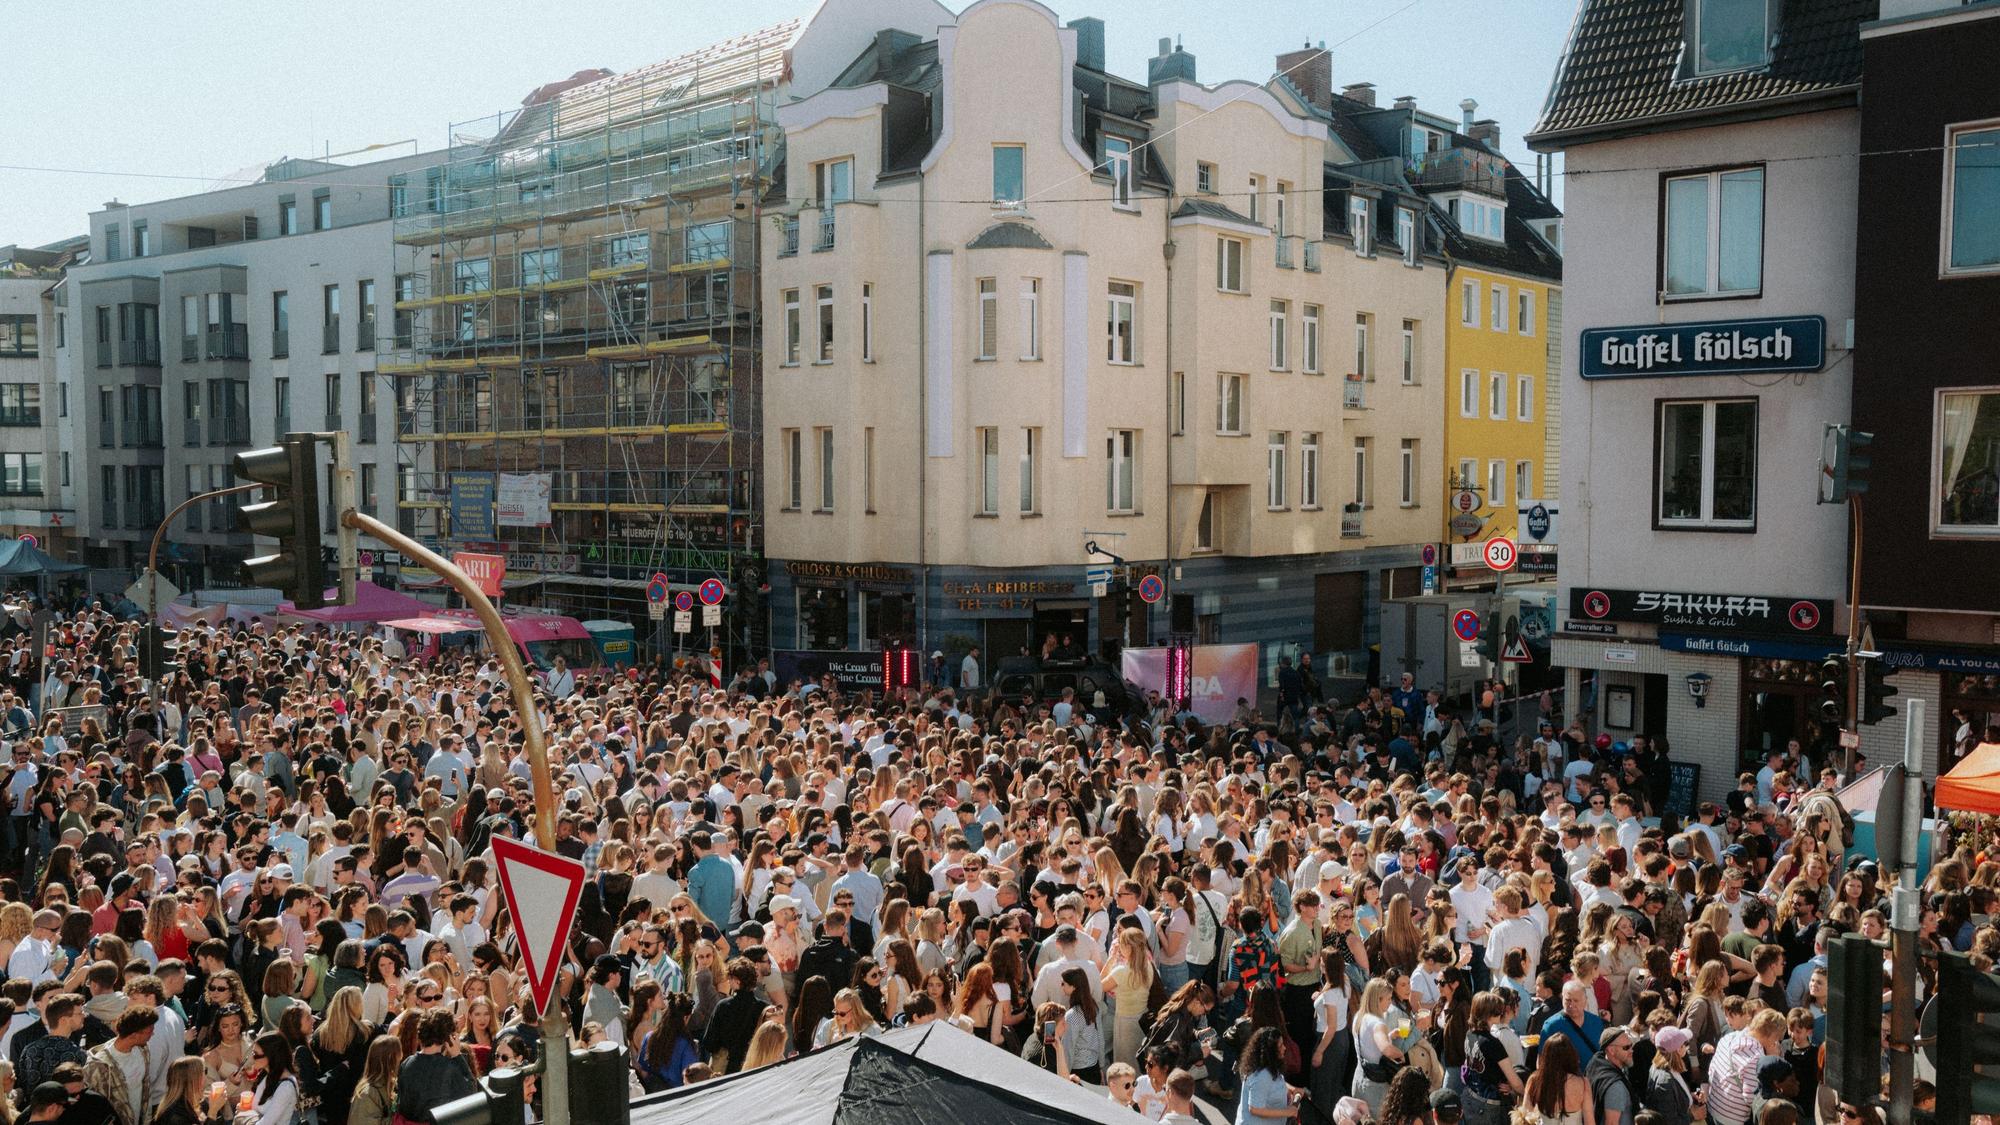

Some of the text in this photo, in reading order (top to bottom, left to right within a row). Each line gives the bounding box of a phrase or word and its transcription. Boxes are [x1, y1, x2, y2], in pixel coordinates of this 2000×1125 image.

[1601, 327, 1793, 370] Gaffel Kölsch
[1528, 518, 1548, 526] Gaffel
[509, 553, 536, 568] SHOP
[1491, 546, 1510, 561] 30
[784, 561, 831, 577] SCHLOSS
[834, 564, 843, 578] &
[1633, 592, 1770, 618] SAKURA
[1663, 613, 1737, 628] Sushi & Grill
[1685, 638, 1750, 653] Gaffel Kölsch
[829, 662, 844, 672] Die
[1938, 658, 1958, 666] ALL
[1961, 659, 1982, 668] YOU
